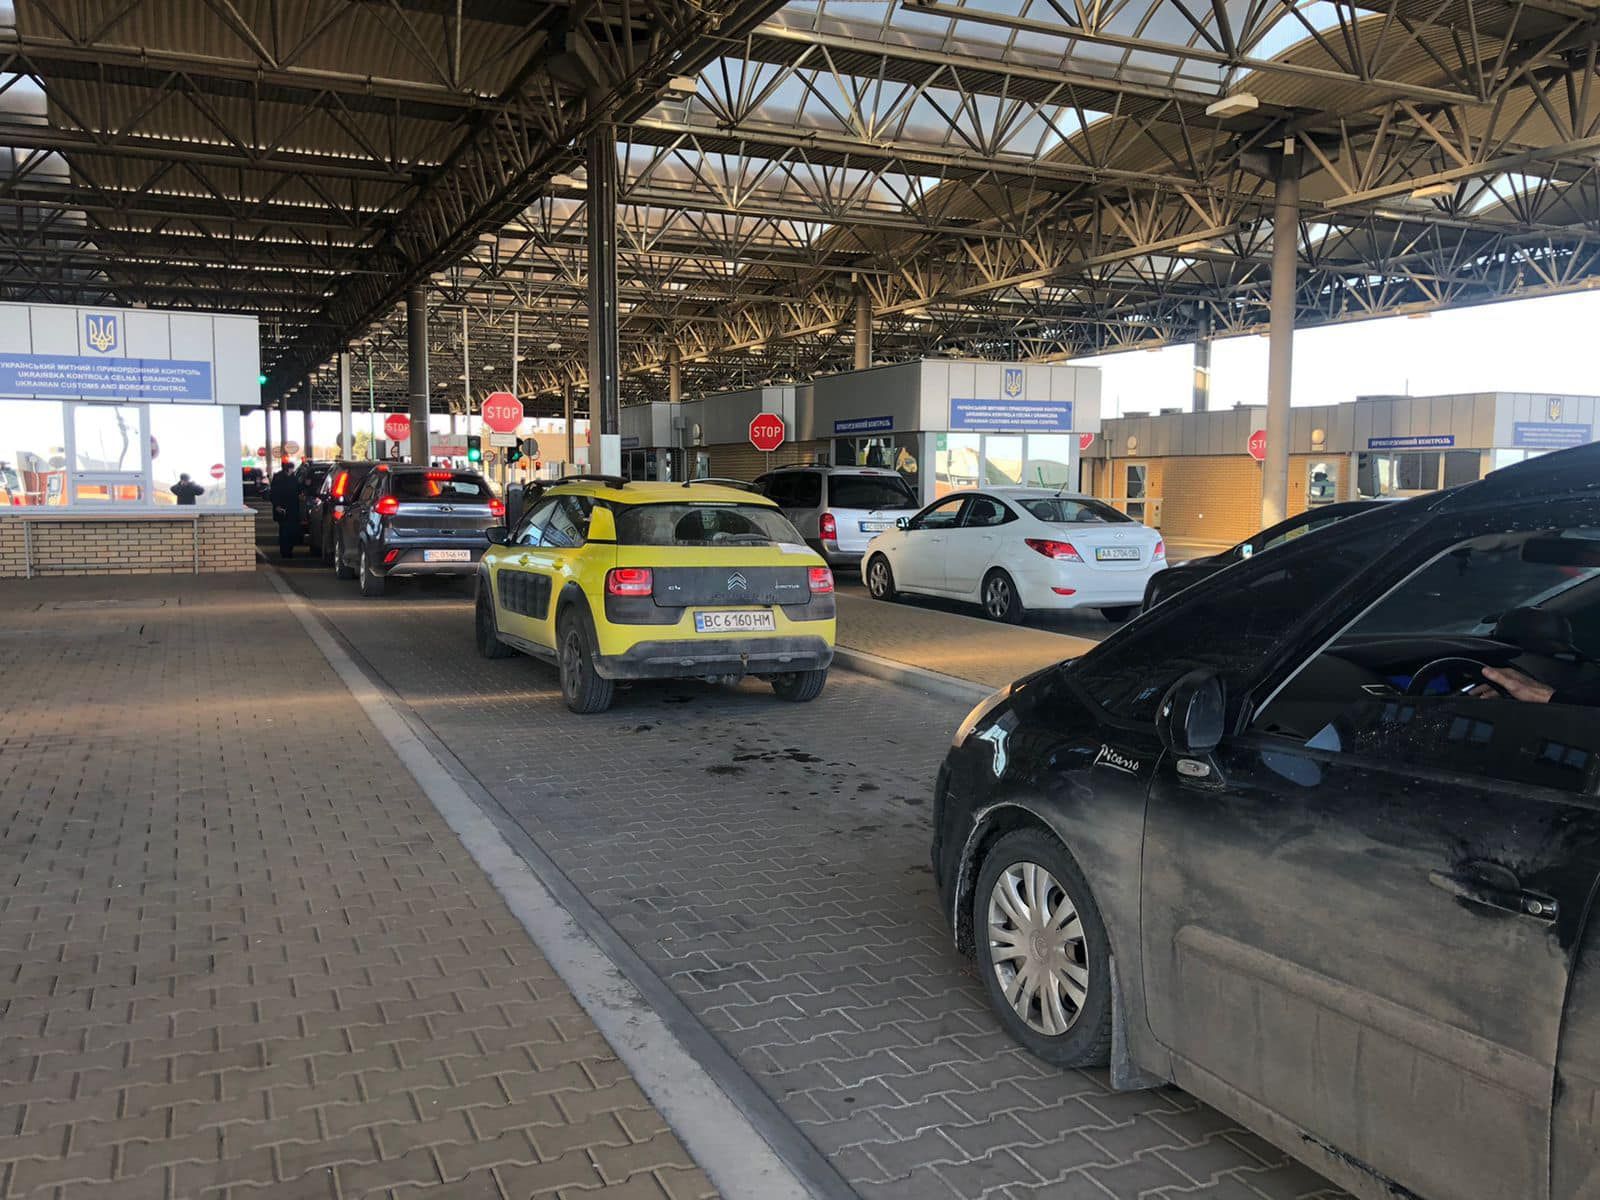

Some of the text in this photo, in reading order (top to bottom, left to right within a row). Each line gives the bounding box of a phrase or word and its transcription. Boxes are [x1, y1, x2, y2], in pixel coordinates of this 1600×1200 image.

[66, 373, 109, 381] KONTROLA
[16, 380, 60, 388] UKRAINIAN
[61, 382, 99, 390] CUSTOMS
[152, 385, 188, 393] CONTROL
[487, 405, 519, 419] STOP
[385, 422, 410, 432] STOP
[753, 426, 781, 438] STOP
[1251, 439, 1266, 449] ST
[704, 613, 771, 627] BC 6160 HM
[1093, 743, 1140, 772] Picasso
